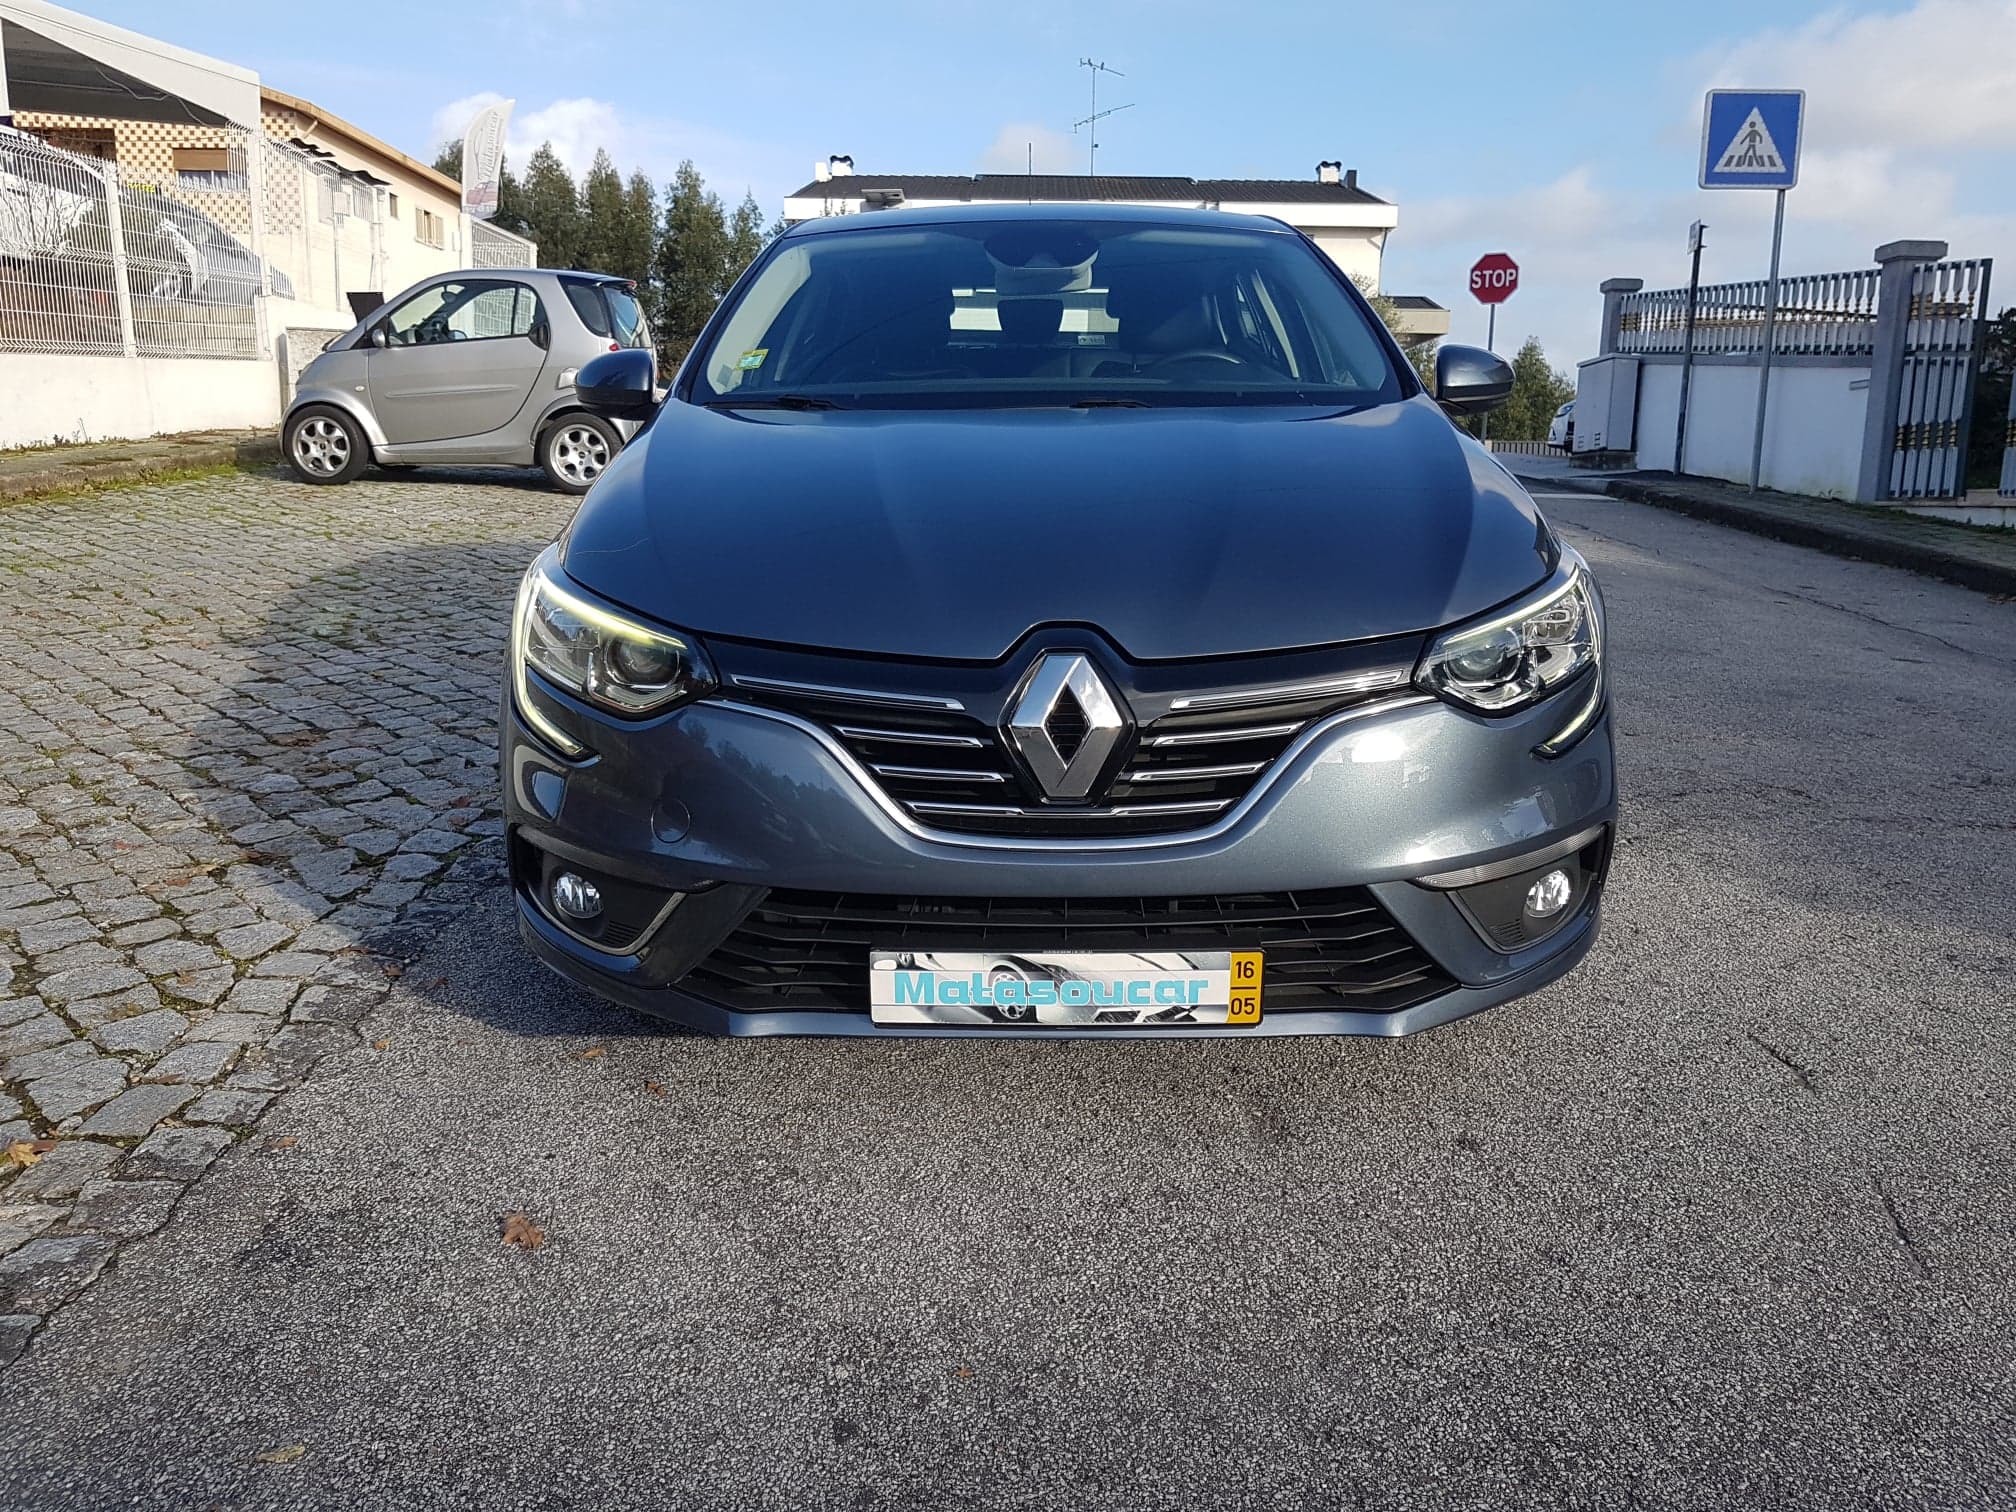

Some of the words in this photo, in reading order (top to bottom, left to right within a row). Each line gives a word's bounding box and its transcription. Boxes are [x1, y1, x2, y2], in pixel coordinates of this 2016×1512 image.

[1471, 268, 1517, 289] STOP
[1235, 960, 1255, 979] 16
[893, 971, 1209, 1006] Matasoucar
[1230, 997, 1255, 1016] 05
